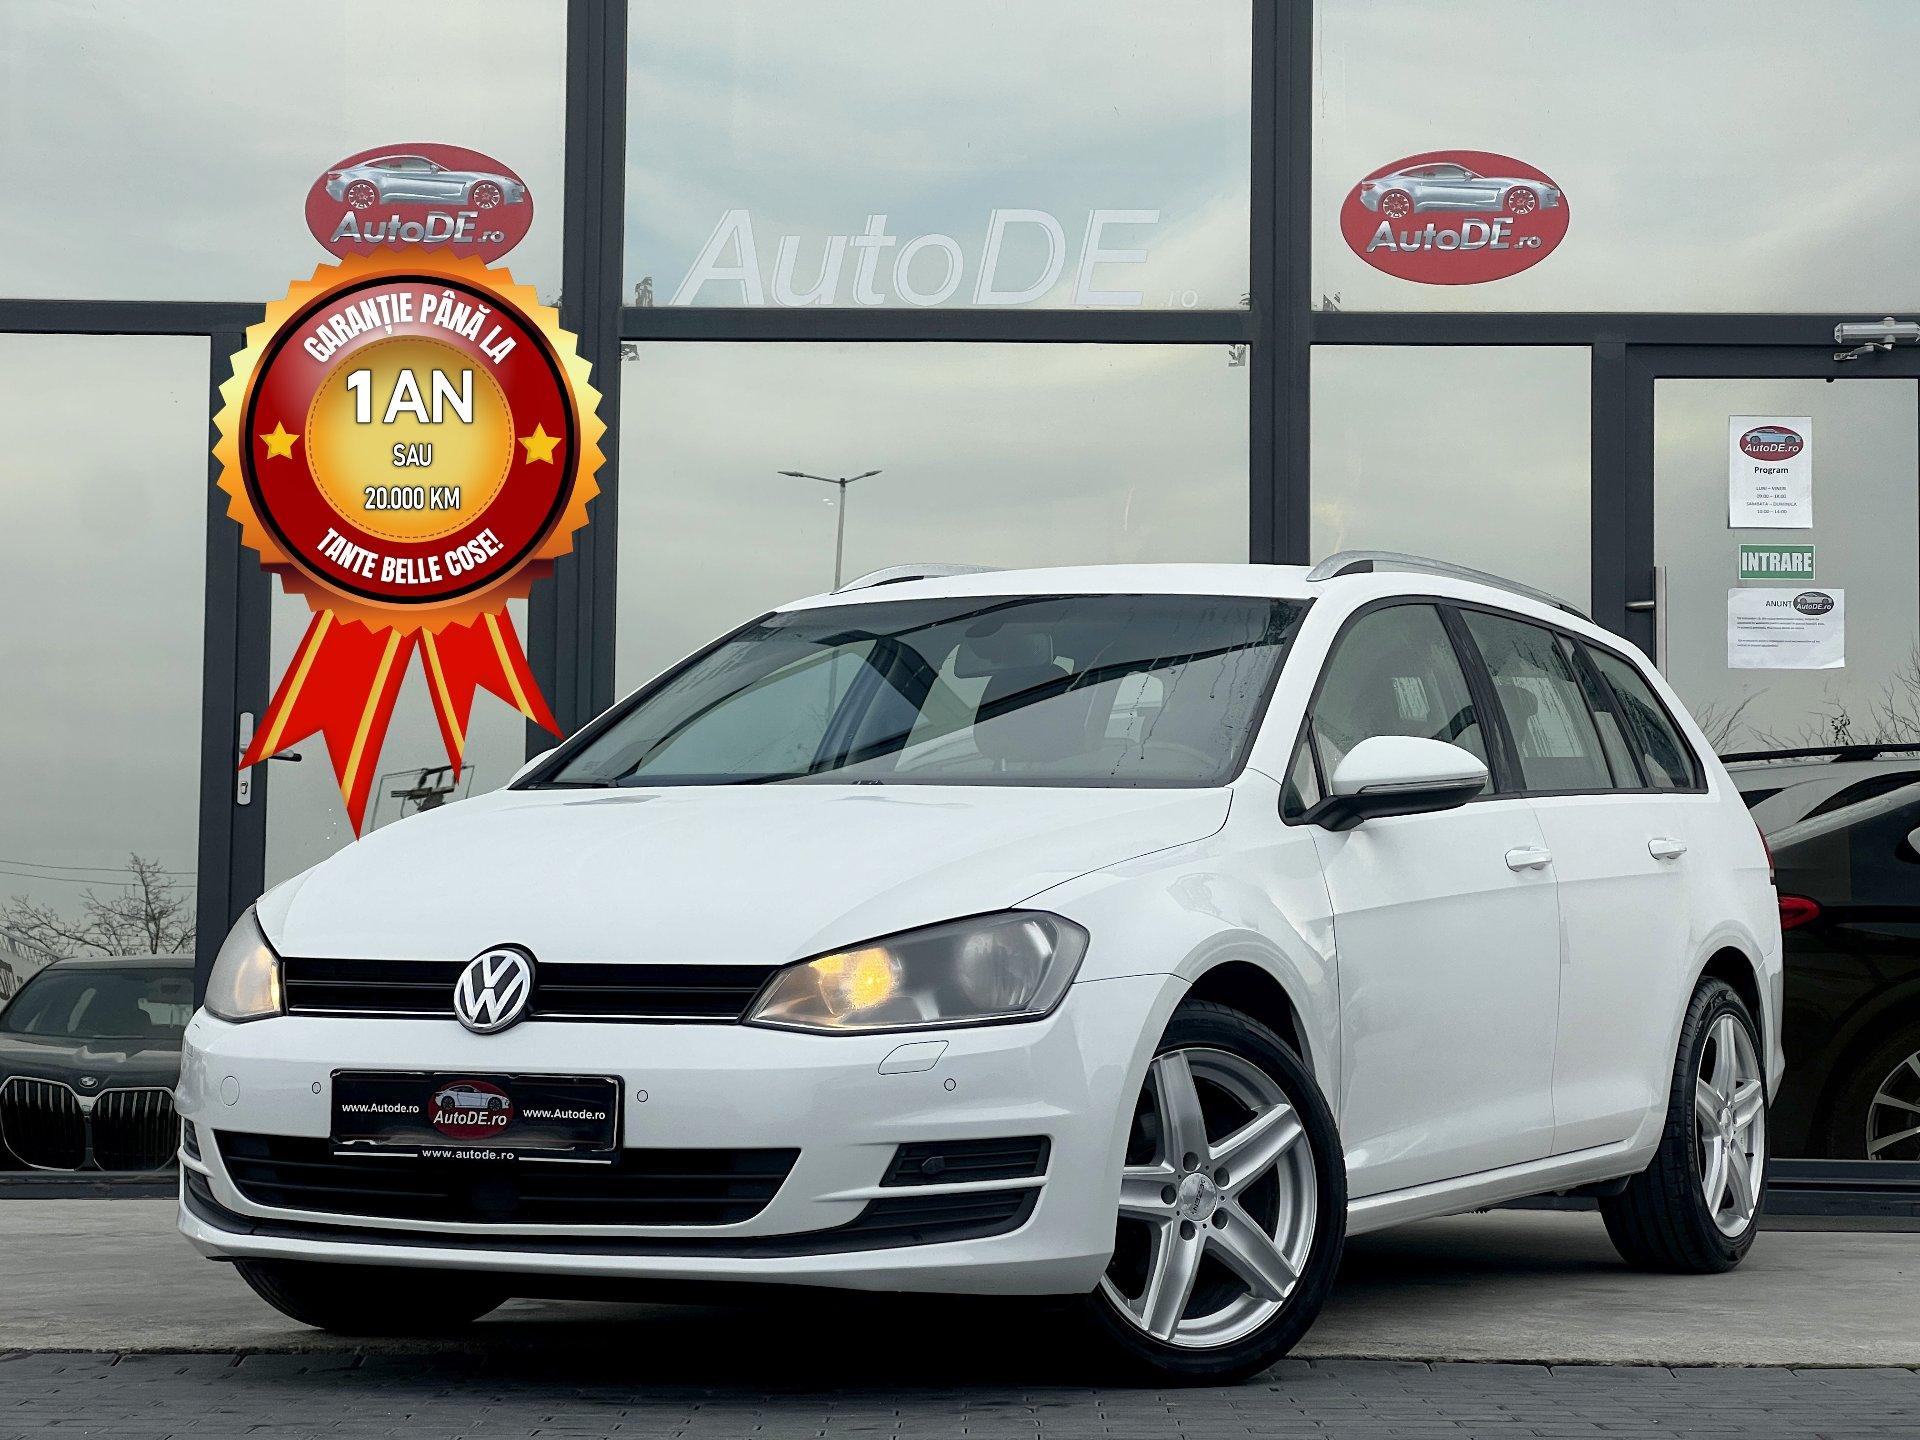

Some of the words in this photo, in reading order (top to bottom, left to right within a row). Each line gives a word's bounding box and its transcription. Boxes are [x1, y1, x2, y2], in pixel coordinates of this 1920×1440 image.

[1754, 466, 1789, 475] Program
[1741, 552, 1812, 572] INTRARE
[341, 1102, 420, 1113] www.Autode.ro
[433, 1109, 507, 1127] AutoDE.ro
[522, 1108, 606, 1120] www.Autode.ro
[421, 1149, 515, 1161] www.autode.ro
